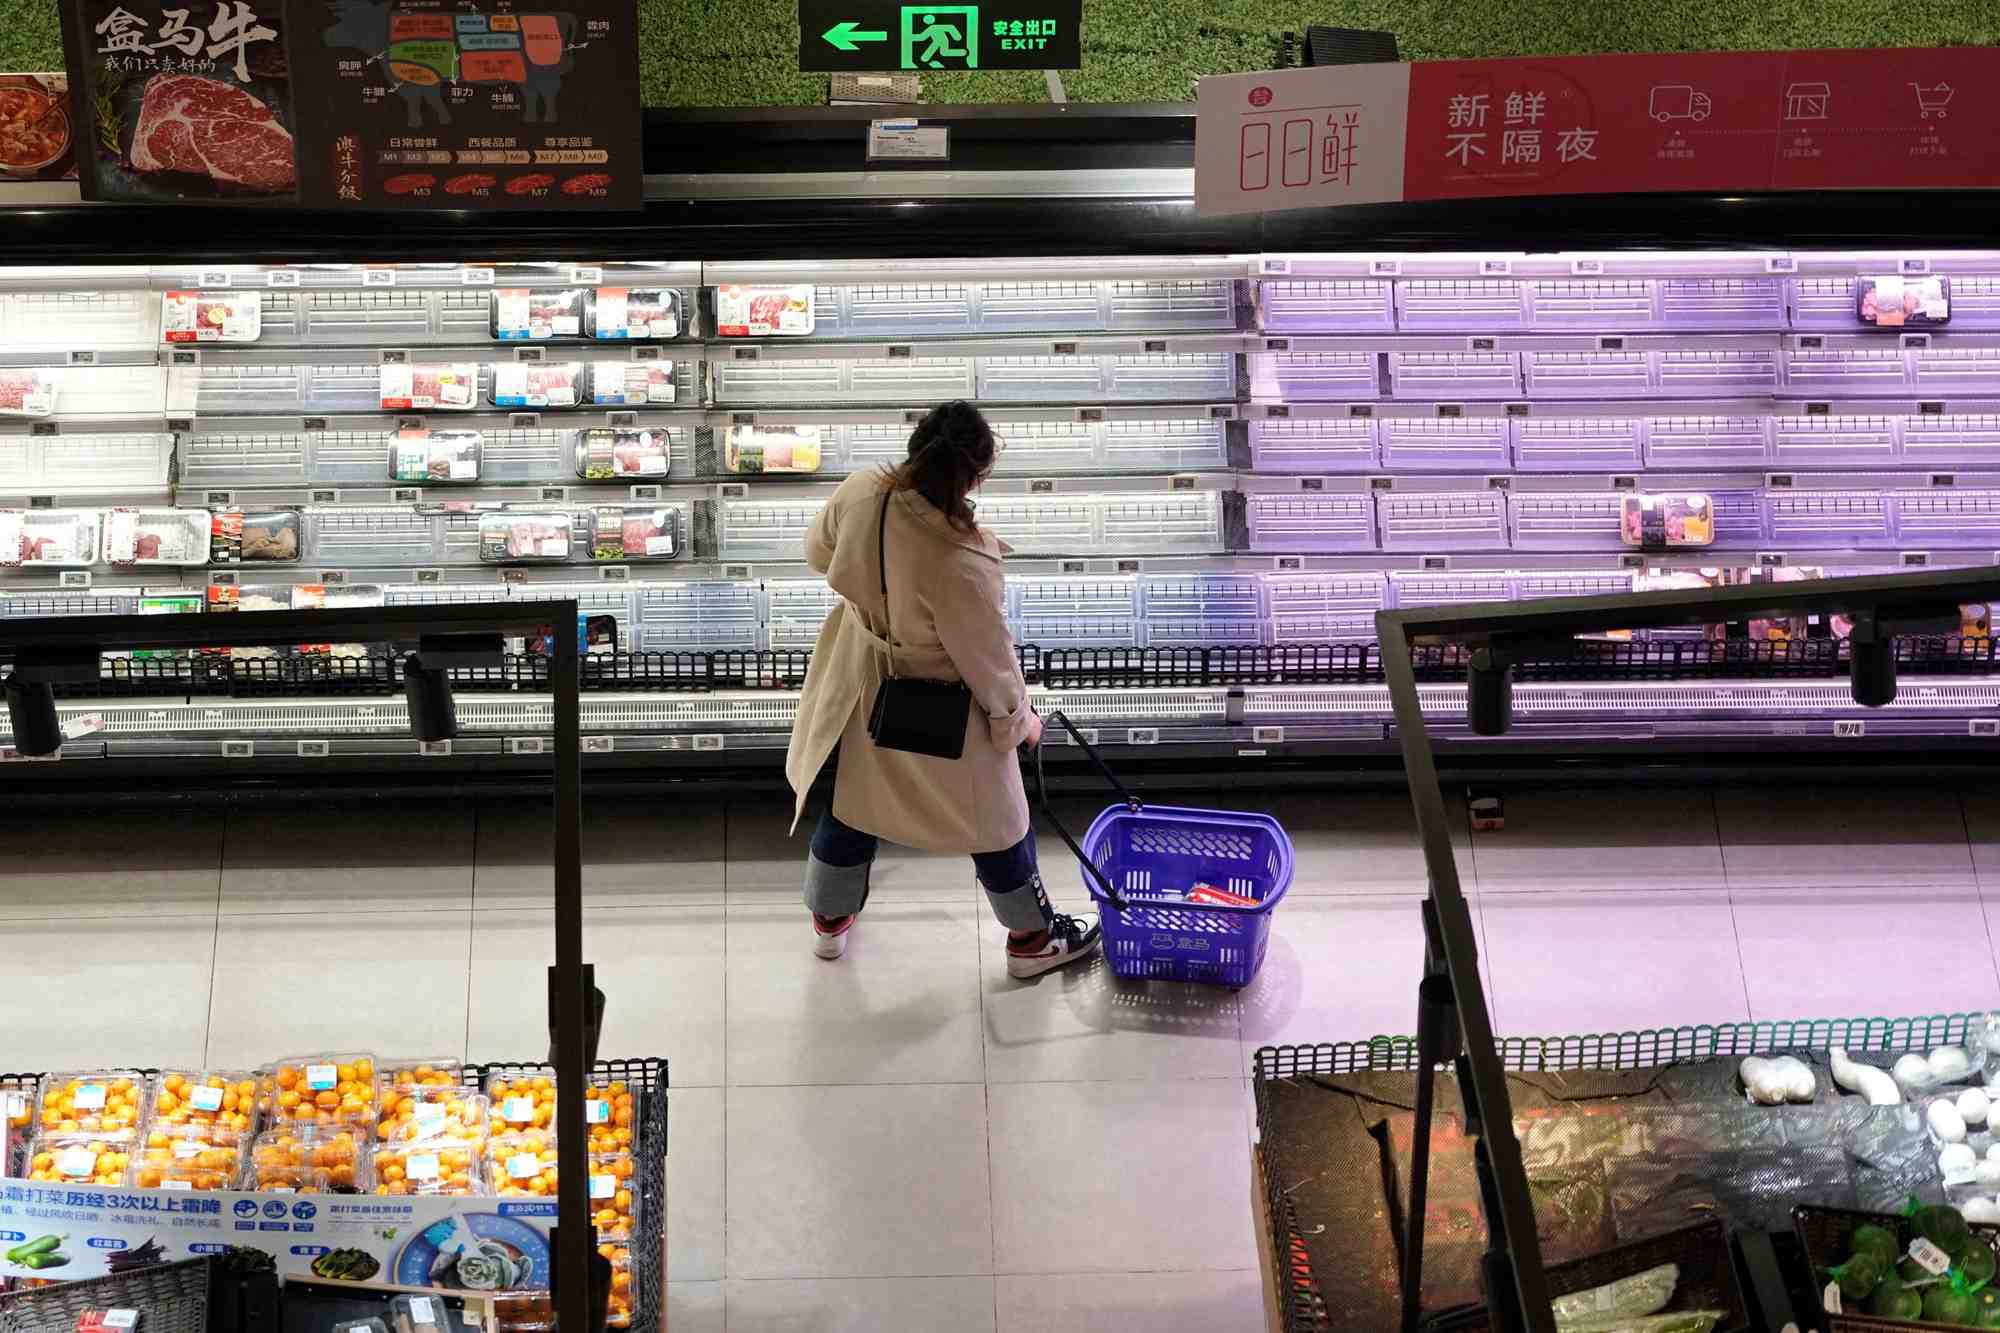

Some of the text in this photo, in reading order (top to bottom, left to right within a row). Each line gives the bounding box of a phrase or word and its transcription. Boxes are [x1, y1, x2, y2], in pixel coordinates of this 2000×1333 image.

[96, 1, 277, 82] 盒马牛
[993, 20, 1056, 36] 安全出口
[1001, 39, 1047, 49] EXIT
[104, 55, 216, 73] 我们只卖好的
[1447, 91, 1547, 127] 新鲜
[1240, 113, 1360, 191] 日日鲜
[1445, 127, 1599, 166] 不隔夜
[414, 188, 607, 196] M3 M5 M7 M9
